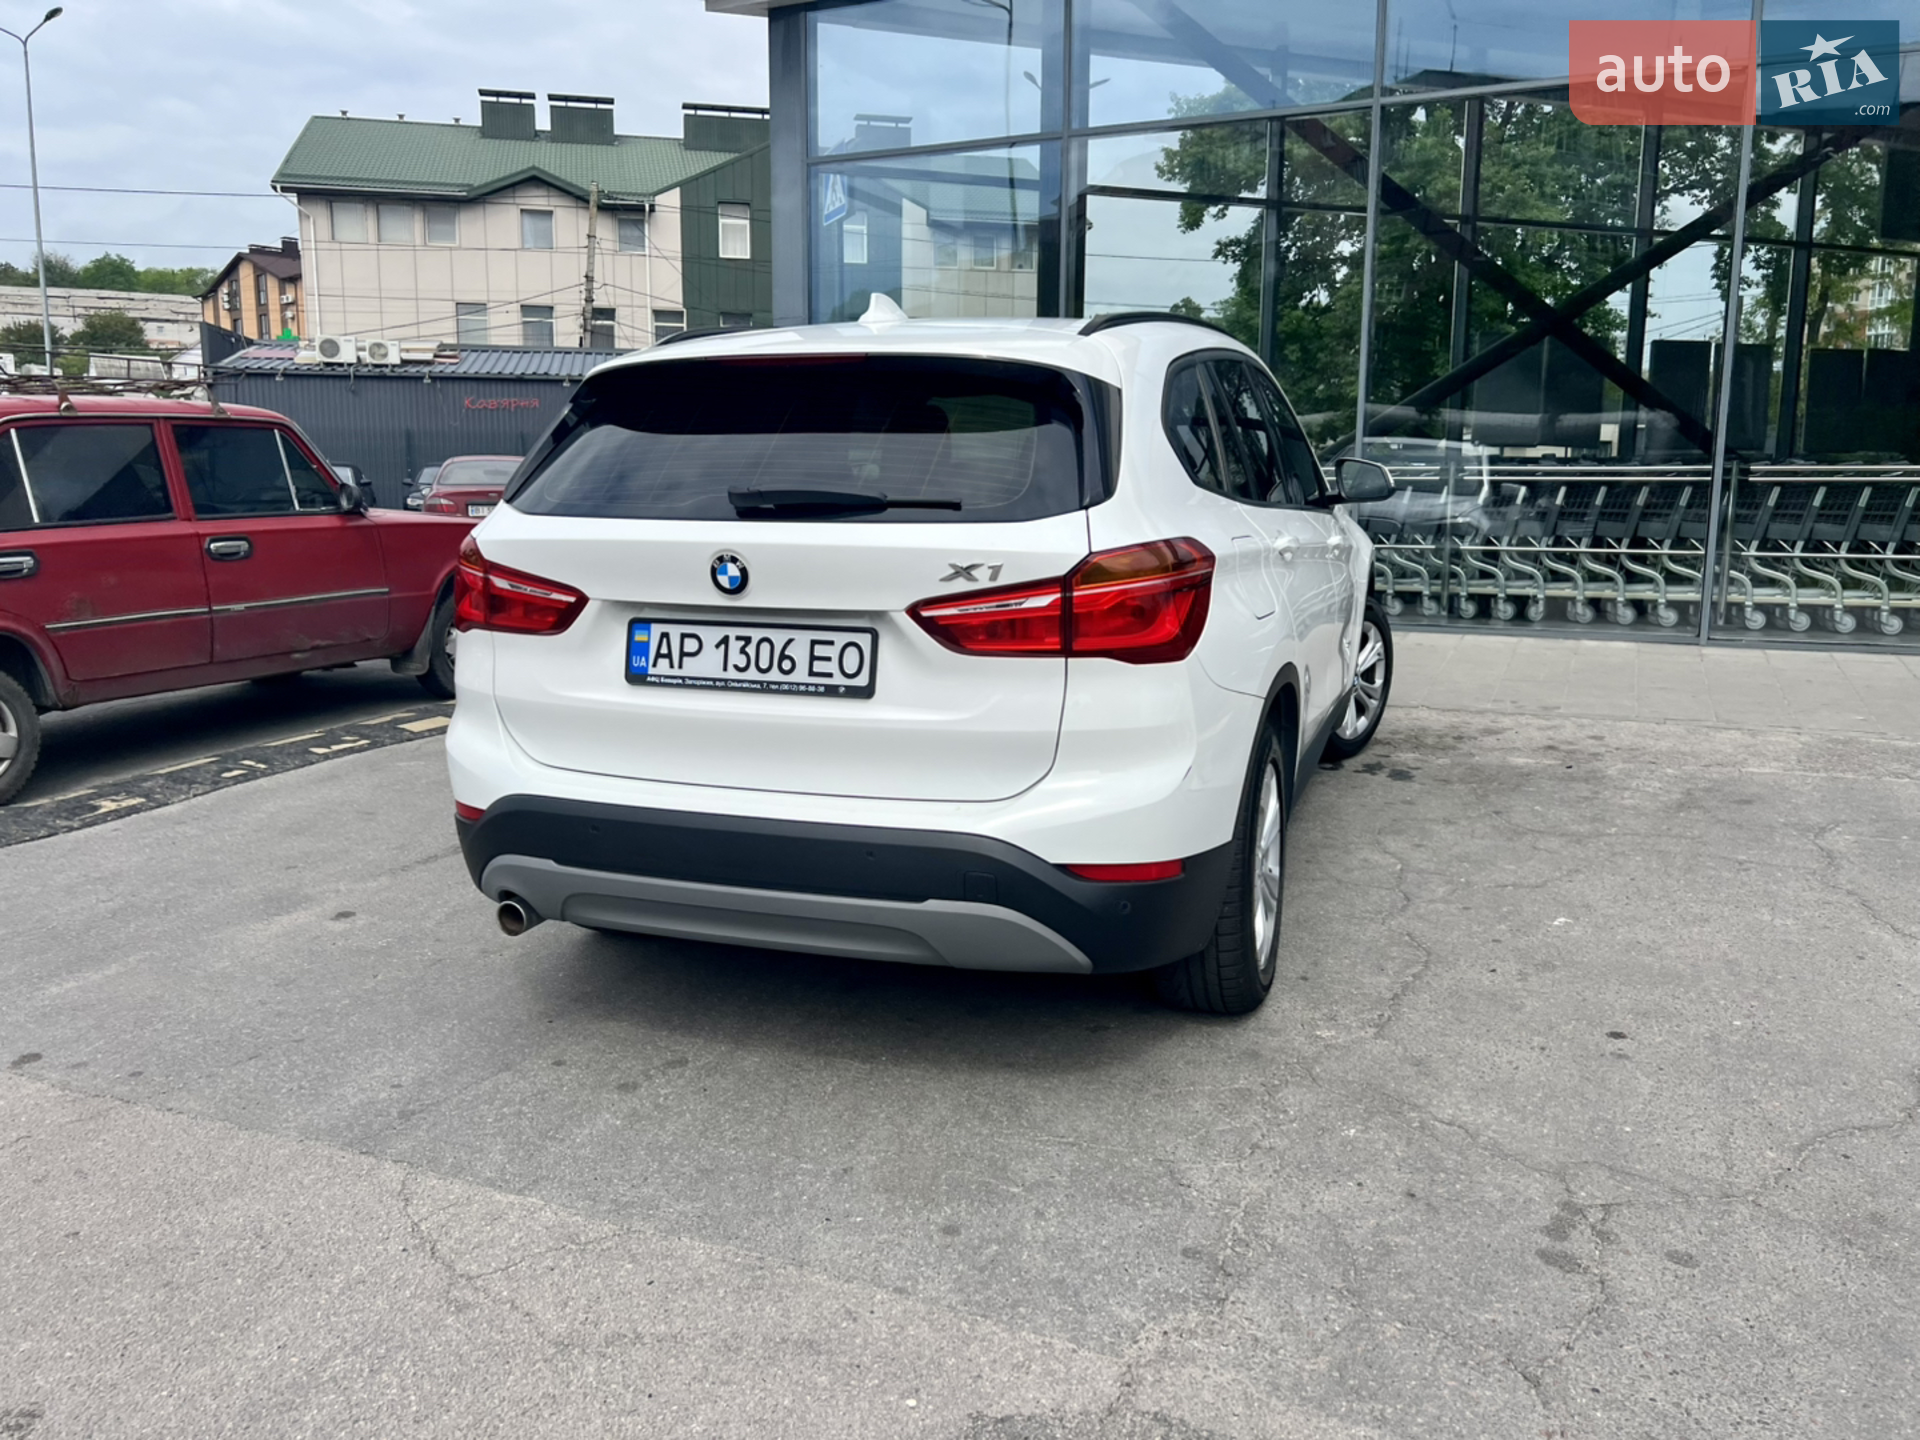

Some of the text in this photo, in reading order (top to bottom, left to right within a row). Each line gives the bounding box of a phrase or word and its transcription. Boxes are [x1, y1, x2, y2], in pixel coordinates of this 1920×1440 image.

[938, 562, 1004, 582] X1
[632, 655, 648, 668] UA
[651, 631, 866, 680] AP 1306 EO
